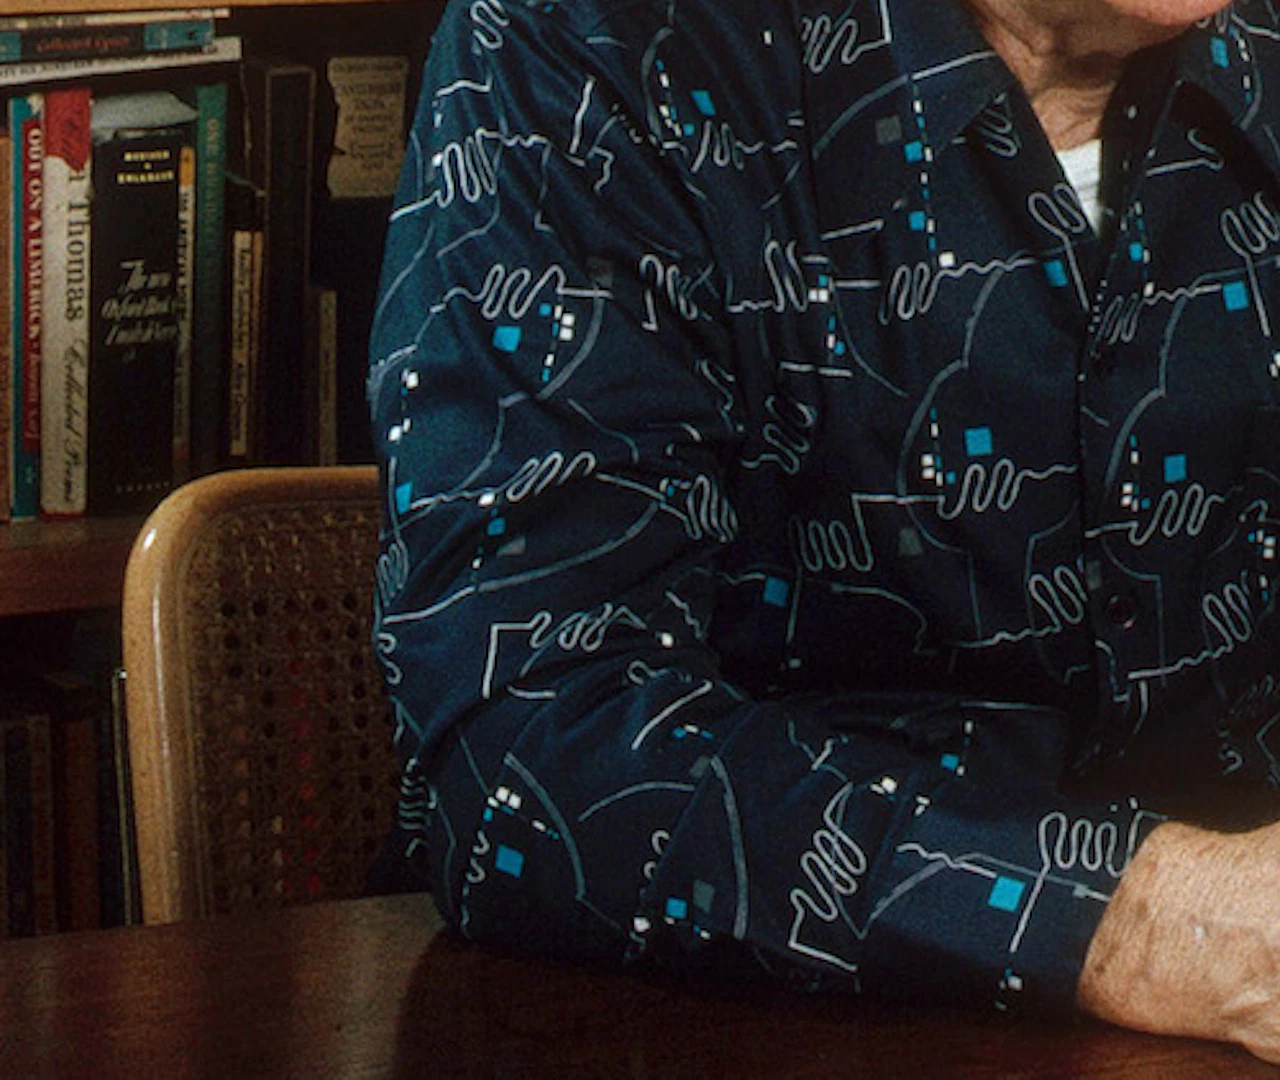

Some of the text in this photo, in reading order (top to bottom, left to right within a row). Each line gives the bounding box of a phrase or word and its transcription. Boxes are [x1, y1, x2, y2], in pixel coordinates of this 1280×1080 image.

[27, 127, 42, 174] OUT
[27, 179, 41, 209] ON
[26, 237, 41, 339] LIMERICK
[65, 199, 90, 321] Thomas
[62, 338, 87, 435] Collected
[61, 437, 84, 504] Poems
